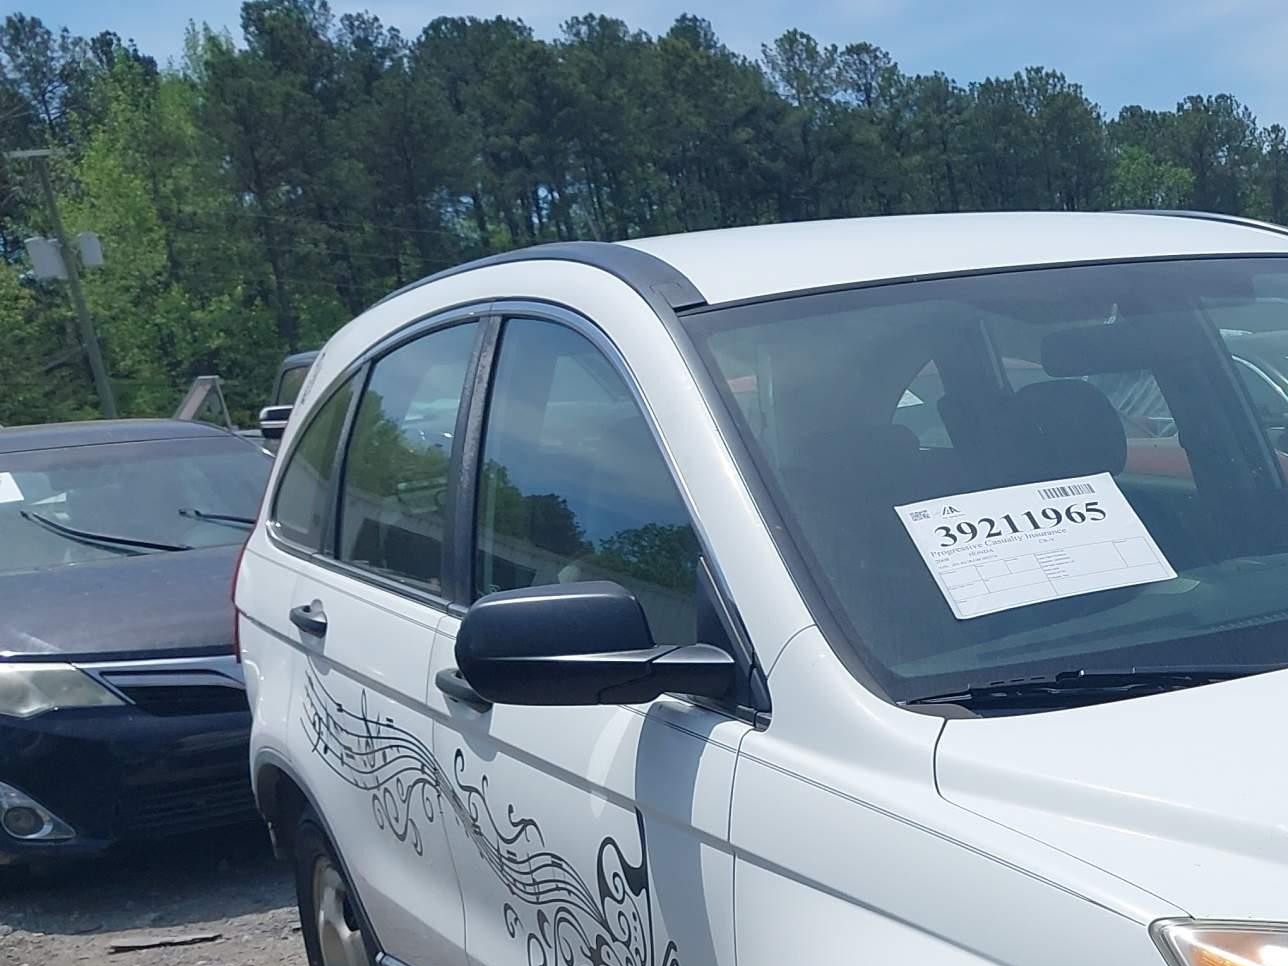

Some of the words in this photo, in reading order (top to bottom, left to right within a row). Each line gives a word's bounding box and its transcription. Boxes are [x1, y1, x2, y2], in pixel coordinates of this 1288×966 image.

[930, 543, 982, 558] Progressive
[984, 534, 1023, 548] Casualty
[1024, 527, 1067, 541] Insurance
[934, 501, 1107, 548] 39211965
